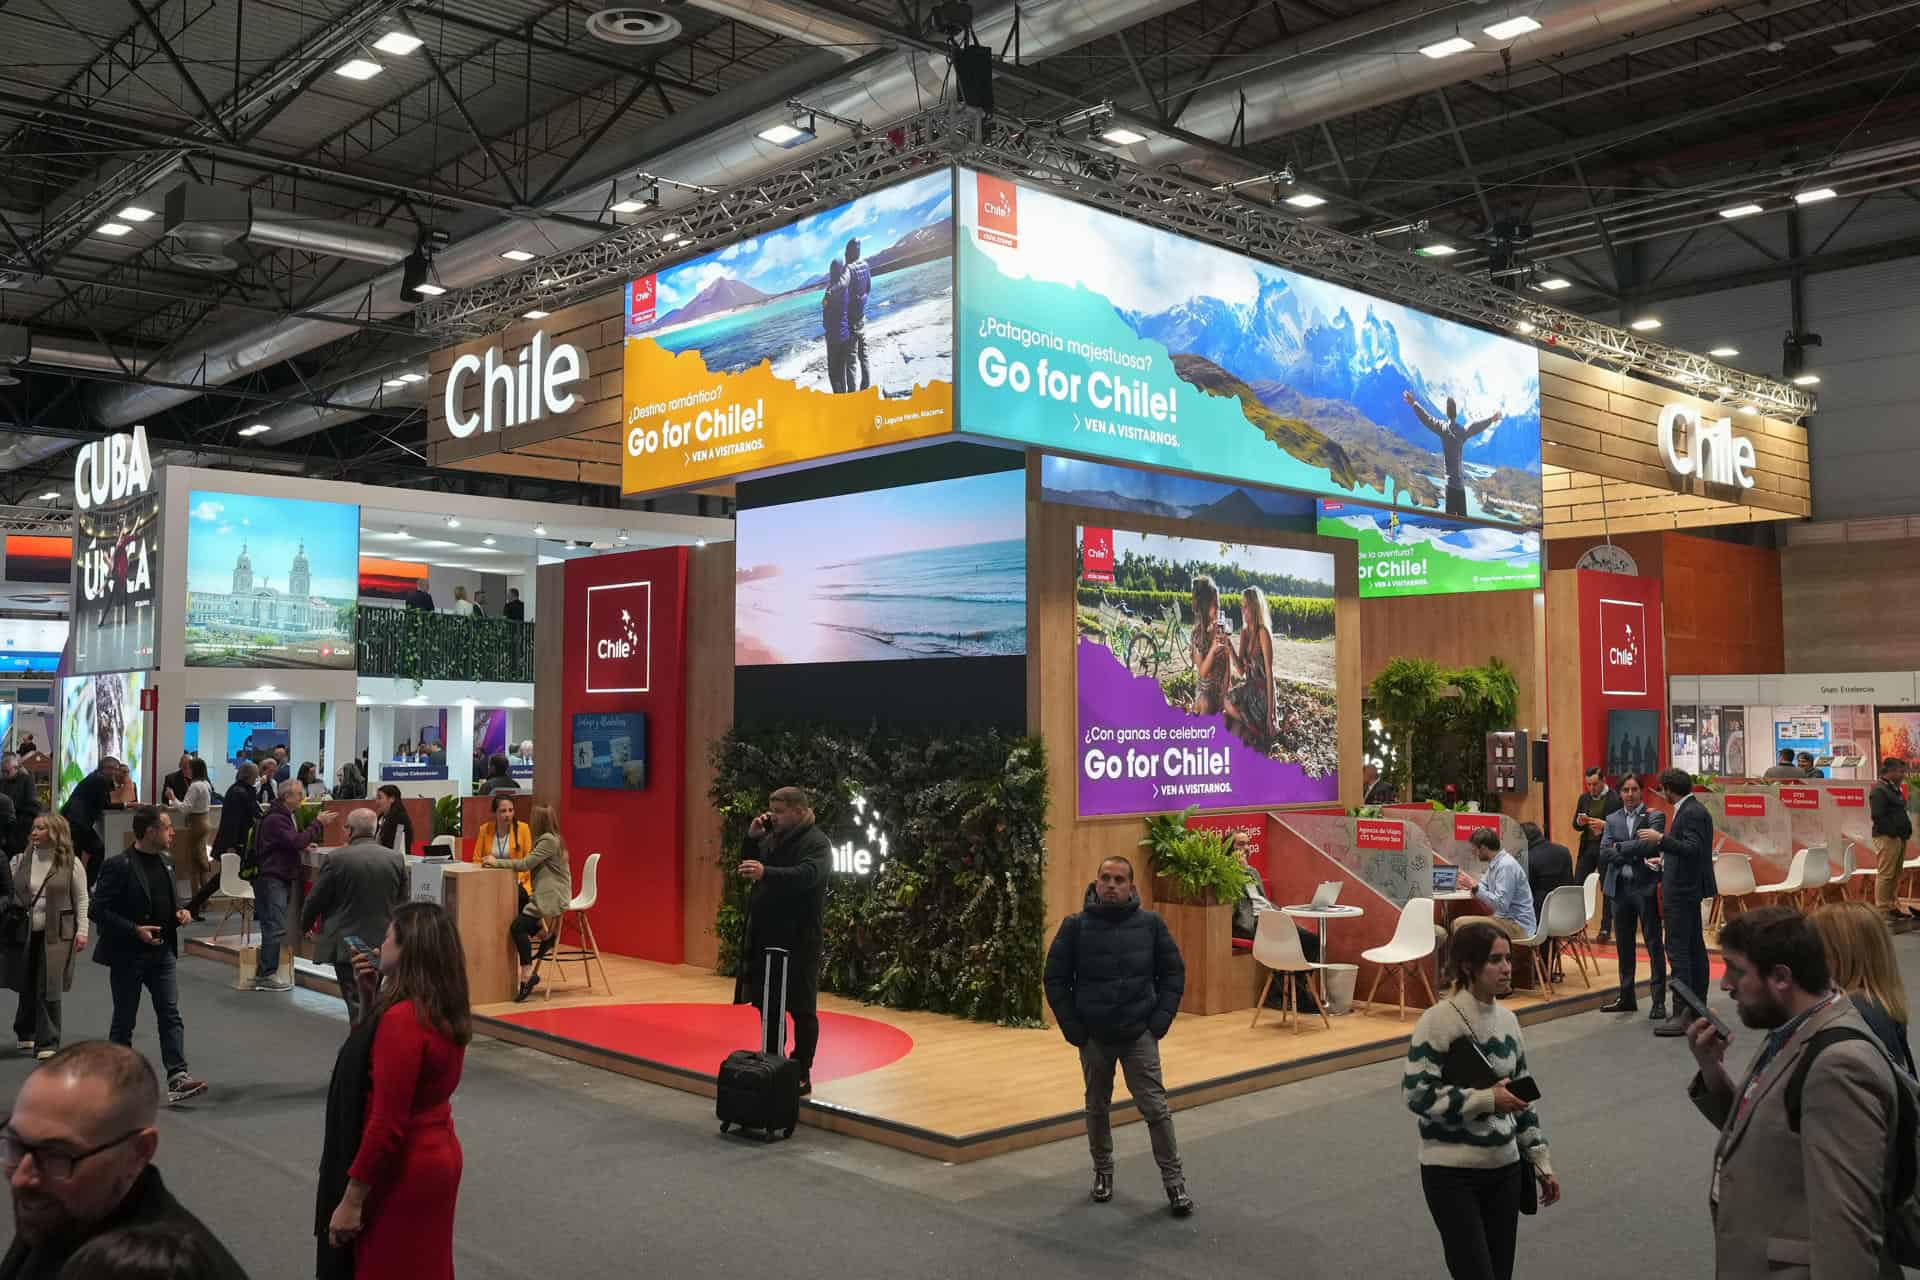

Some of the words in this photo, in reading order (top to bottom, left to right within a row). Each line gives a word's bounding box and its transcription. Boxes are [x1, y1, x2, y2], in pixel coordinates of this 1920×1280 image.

[984, 202, 1006, 217] Chile
[978, 317, 1064, 350] ¿Patagonia
[1067, 339, 1153, 372] majestuosa?
[445, 329, 583, 438] Chile
[978, 346, 1031, 393] Go
[1036, 358, 1082, 403] for
[1087, 371, 1177, 423] Chile!
[628, 401, 667, 425] ¿Destino
[667, 385, 722, 411] romántico?
[627, 427, 659, 457] Go
[661, 419, 692, 449] for
[695, 398, 764, 441] Chile!
[1085, 416, 1107, 433] VEN
[1108, 421, 1116, 435] A
[1117, 423, 1181, 447] VISITARNOS.
[692, 450, 710, 462] VEN
[708, 447, 715, 459] A
[715, 438, 765, 457] VISITARNOS.
[1657, 403, 1756, 488] Chile
[75, 425, 151, 509] CUBA
[83, 537, 151, 601] ÚNCA
[1358, 565, 1374, 579] or
[1376, 558, 1428, 578] Chile!
[597, 638, 630, 659] Chile
[1609, 647, 1633, 665] Chile
[1085, 726, 1114, 744] ¿Con
[1117, 729, 1150, 744] ganas
[1153, 726, 1167, 740] de
[1169, 725, 1216, 740] celebrar?
[1084, 749, 1123, 780] Go
[1126, 748, 1159, 778] for
[1163, 746, 1231, 777] Chile!
[1161, 785, 1177, 796] VEN
[1178, 785, 1184, 795] A
[1185, 782, 1233, 795] VISITARNOS.
[831, 840, 872, 875] ile
[1249, 843, 1260, 856] pa
